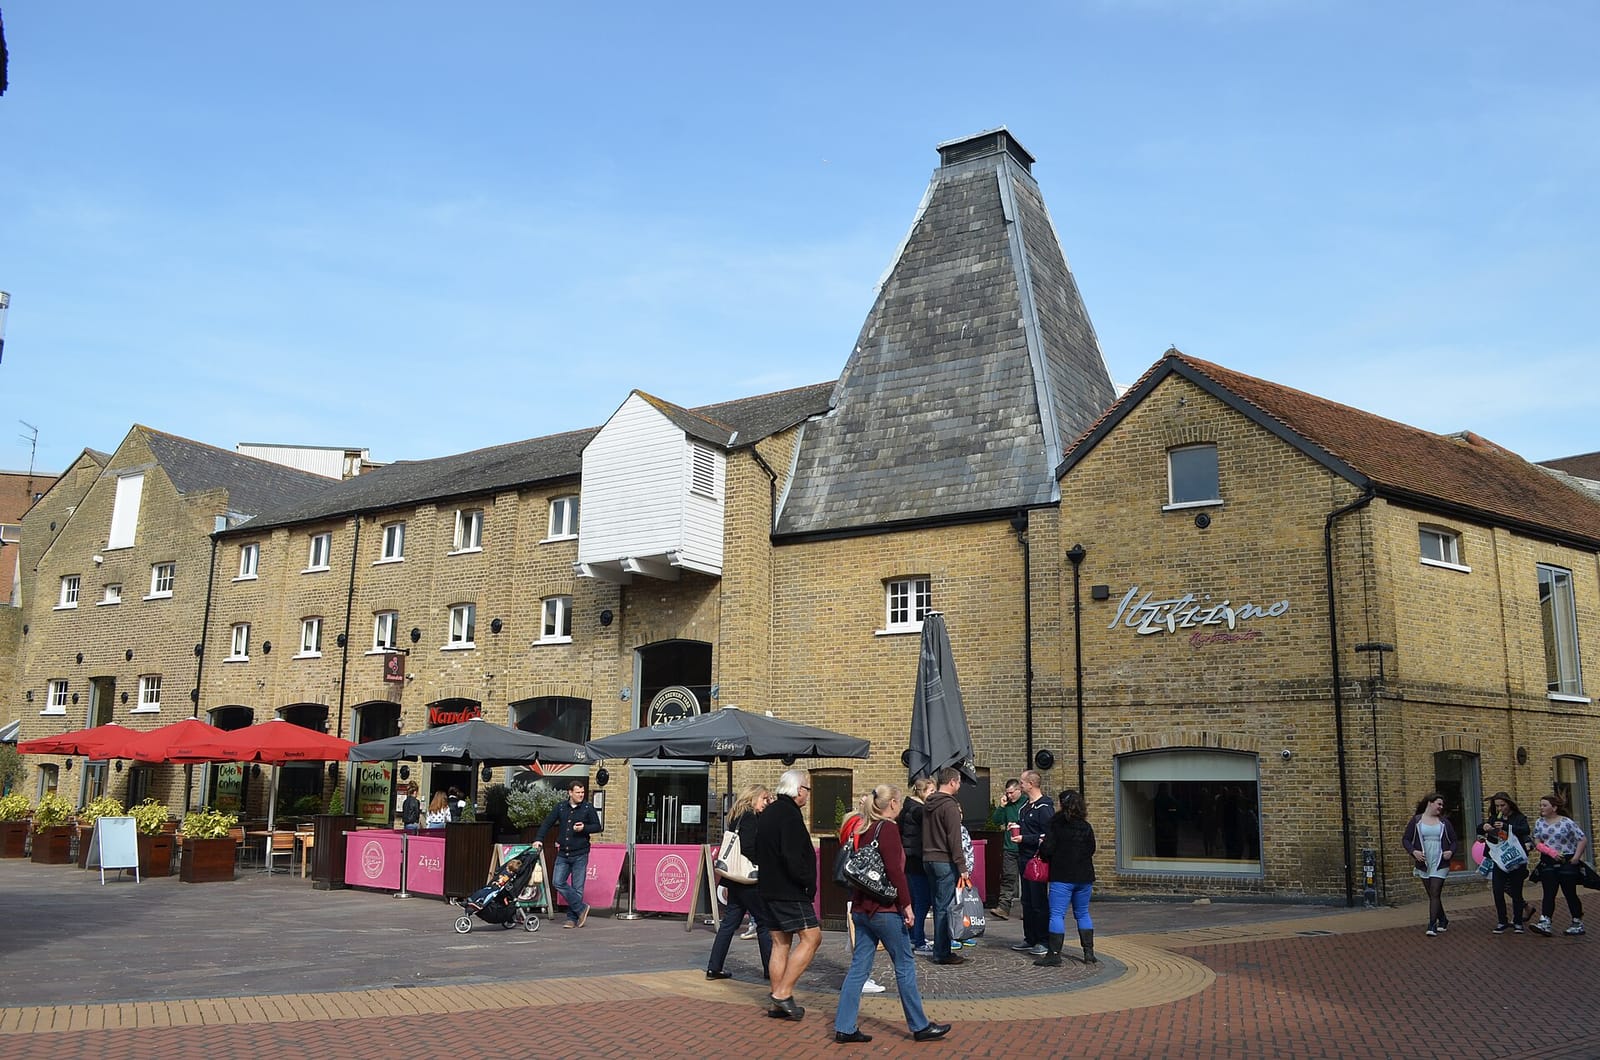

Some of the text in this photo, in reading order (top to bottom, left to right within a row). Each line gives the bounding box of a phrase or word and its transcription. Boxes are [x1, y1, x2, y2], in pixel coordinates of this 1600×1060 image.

[1136, 600, 1236, 635] Zizzi
[362, 768, 383, 781] Order
[361, 781, 389, 796] online
[418, 855, 440, 868] Zizzi
